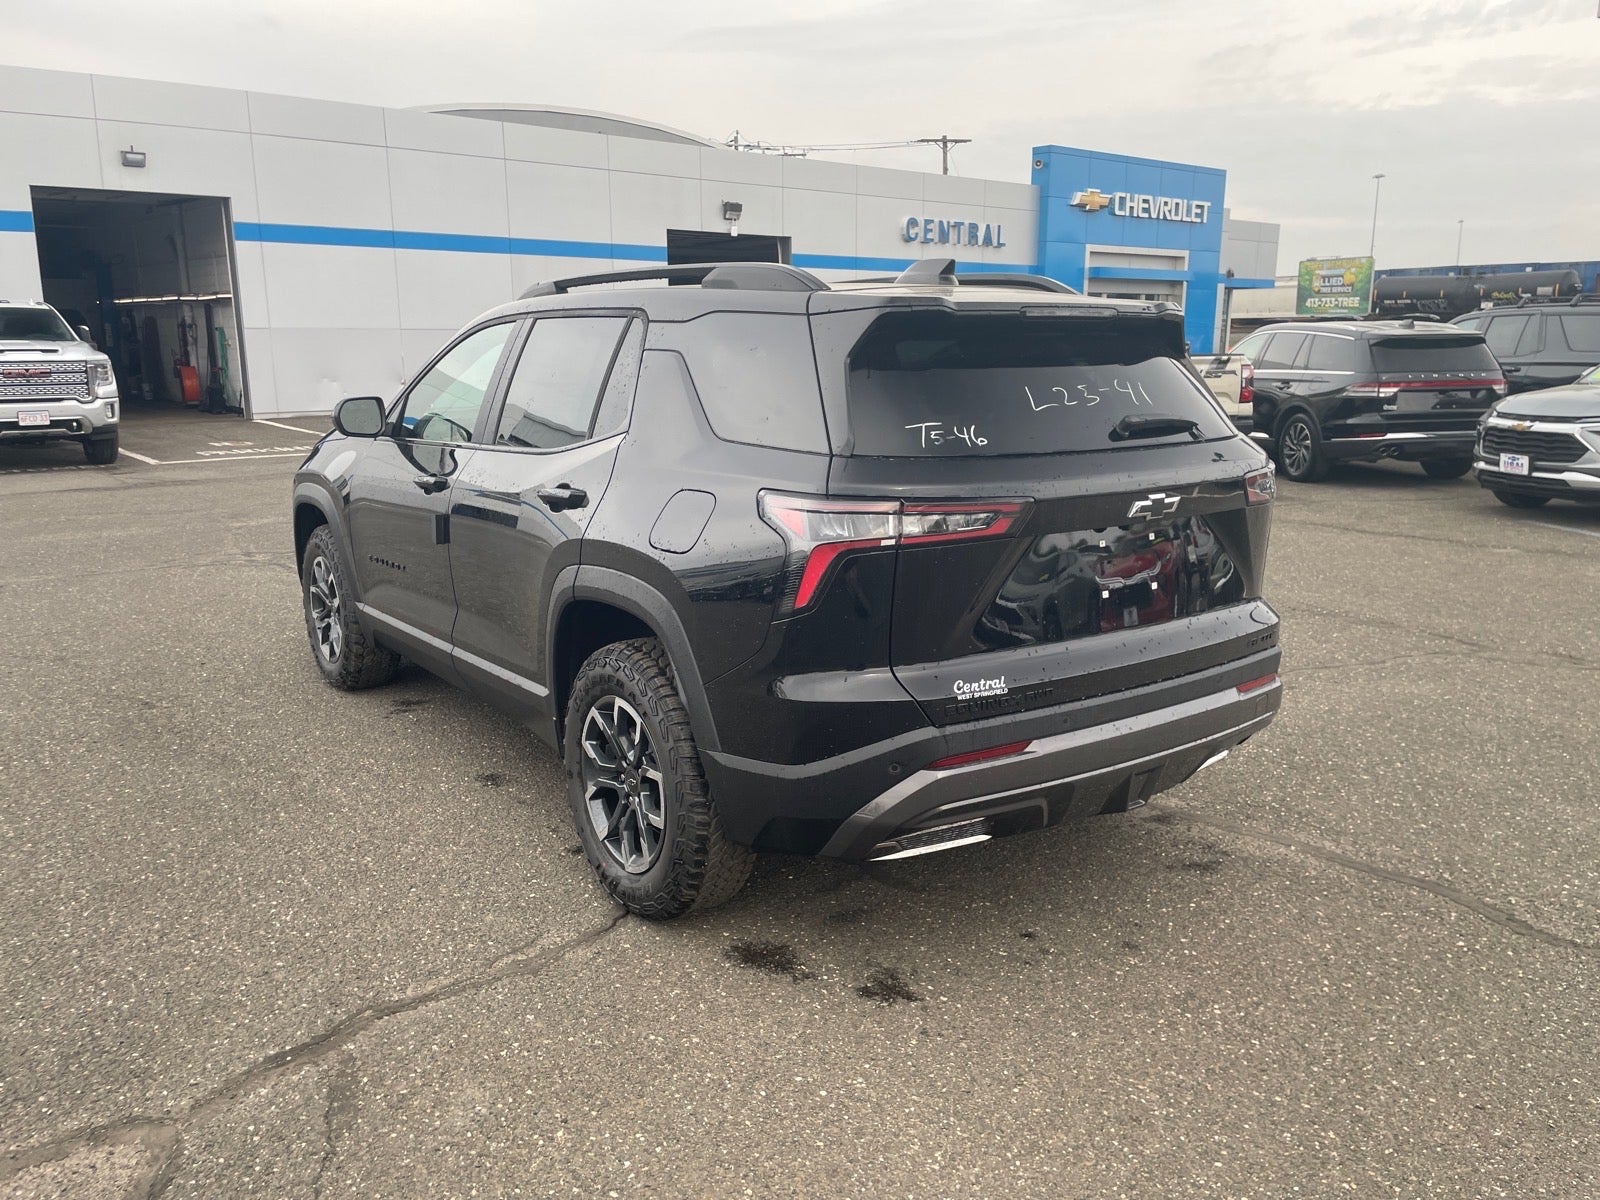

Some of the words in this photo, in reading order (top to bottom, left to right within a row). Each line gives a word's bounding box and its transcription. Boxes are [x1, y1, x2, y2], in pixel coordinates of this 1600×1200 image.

[1113, 191, 1211, 224] CHEVROLET
[902, 216, 1006, 249] CENTRAL
[3, 368, 51, 378] GMC
[953, 675, 1006, 694] Central
[957, 692, 974, 701] WEST
[973, 687, 1009, 699] SPRINGFIELD
